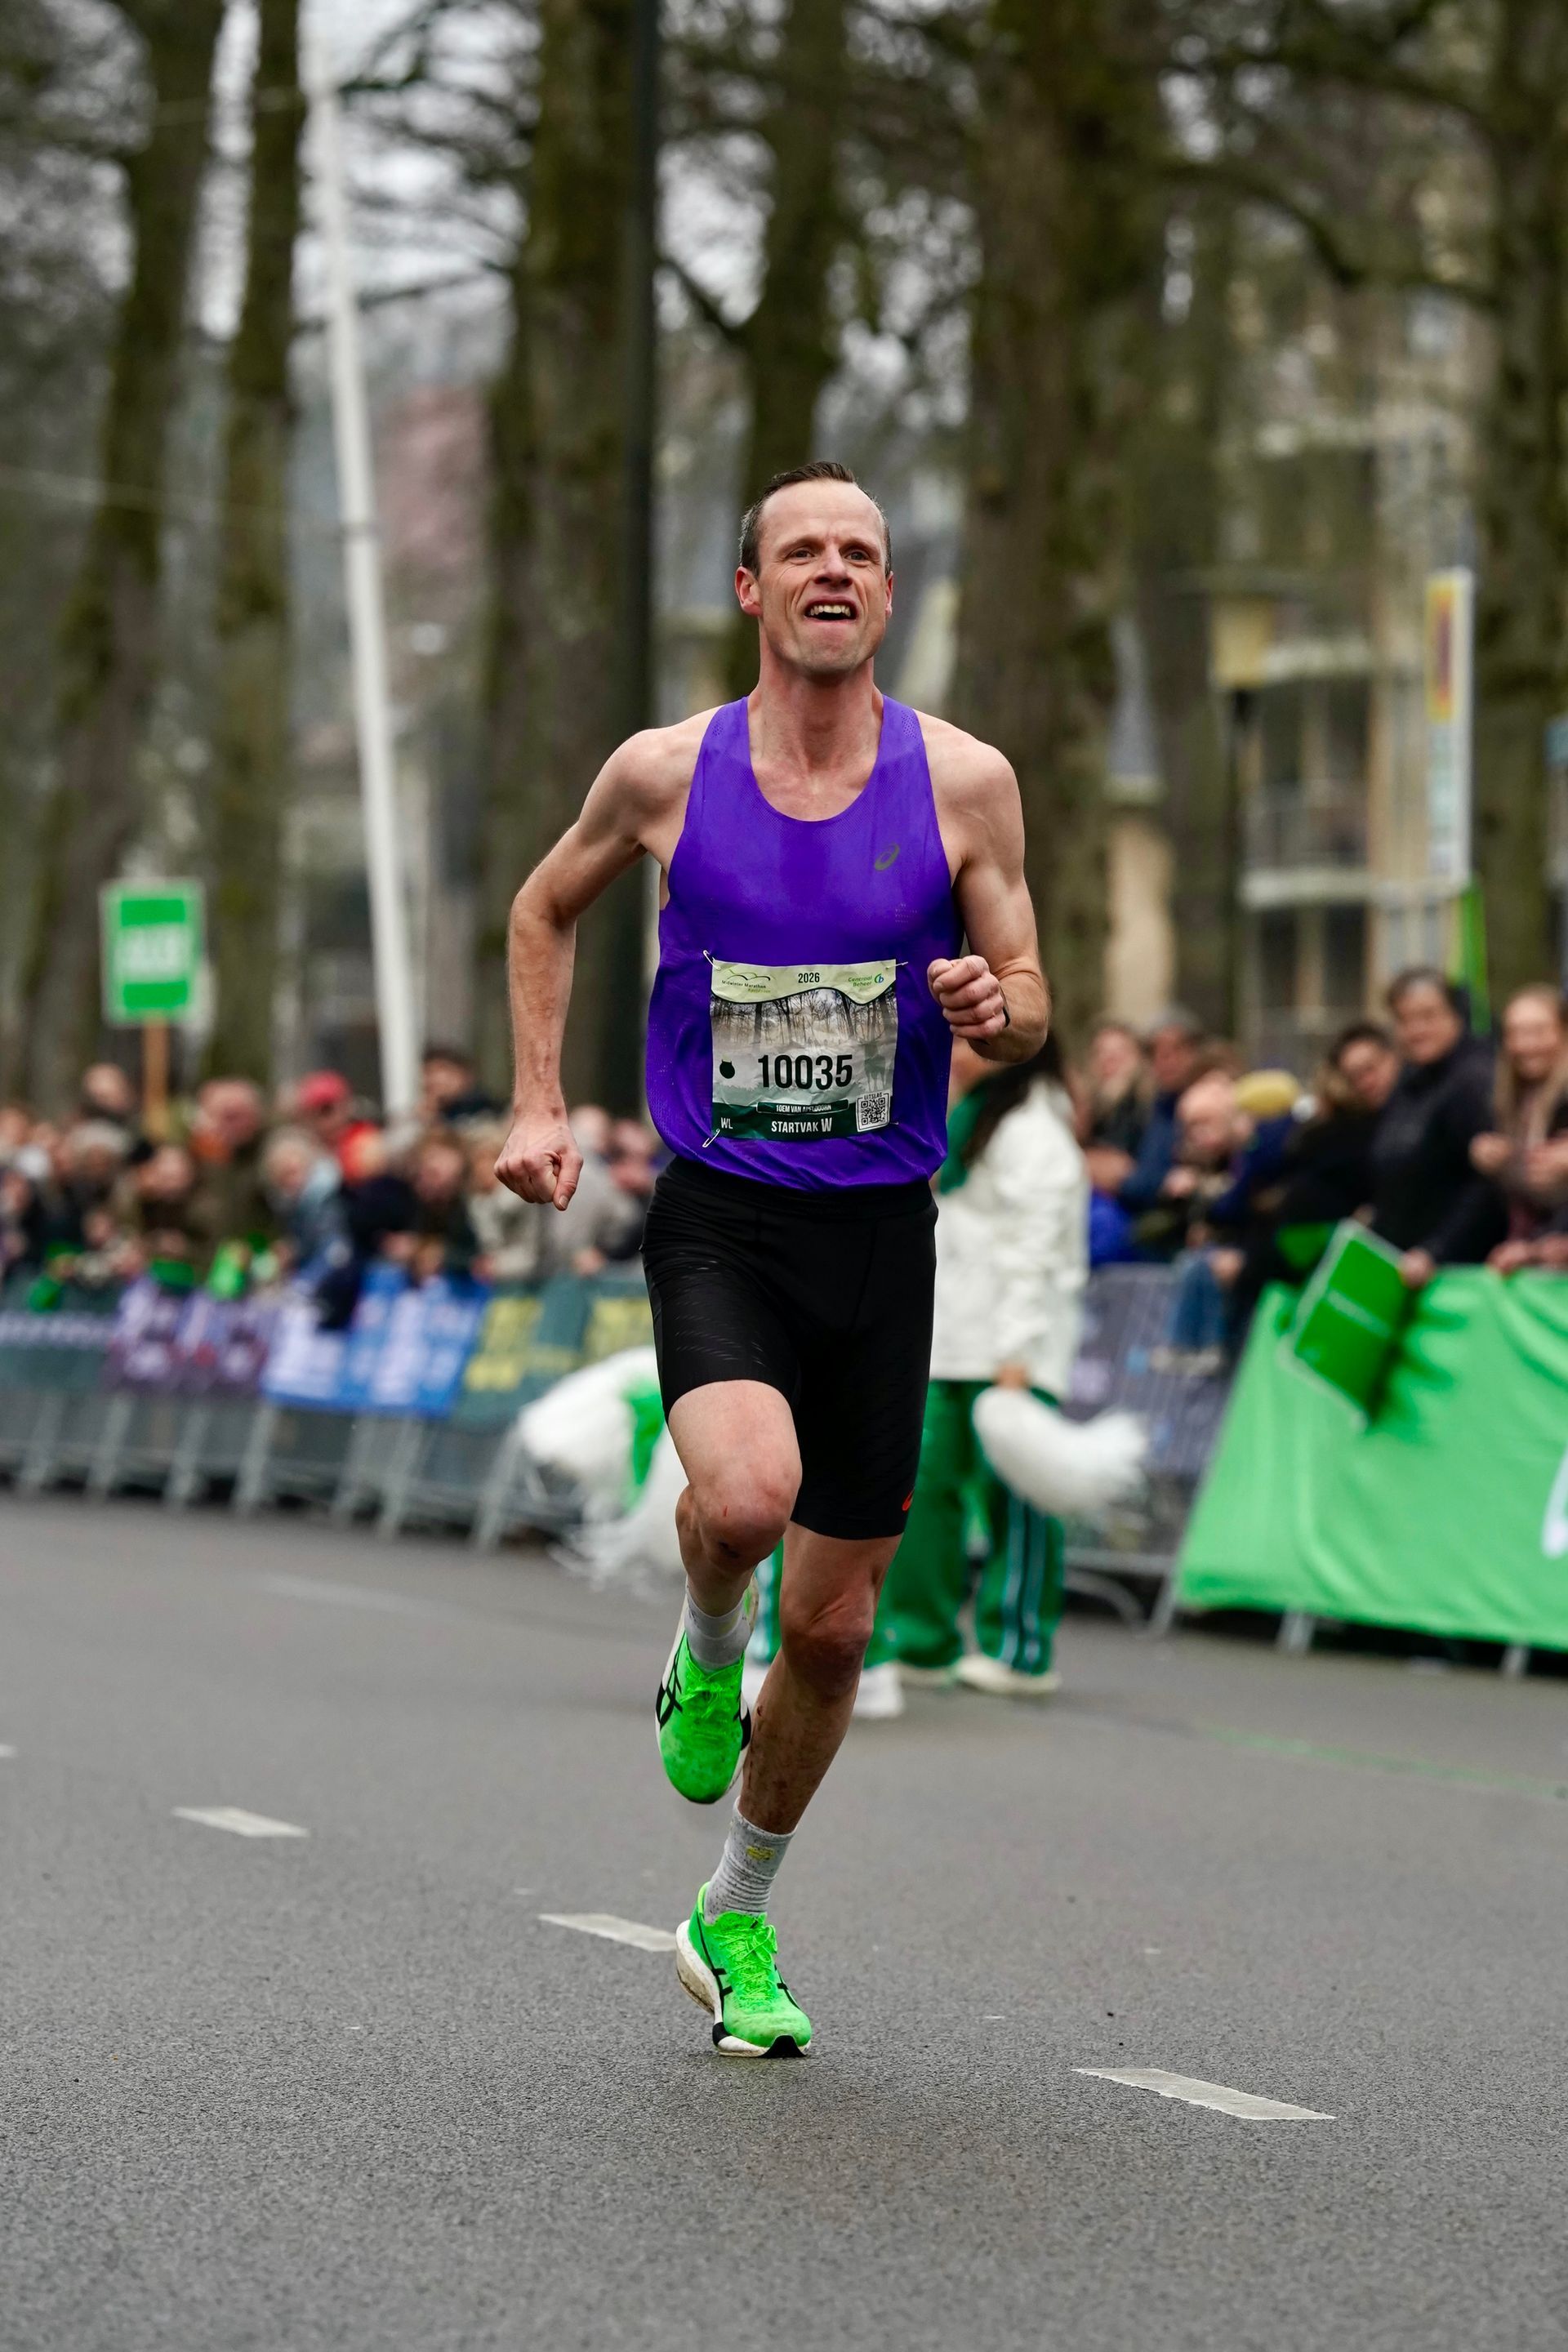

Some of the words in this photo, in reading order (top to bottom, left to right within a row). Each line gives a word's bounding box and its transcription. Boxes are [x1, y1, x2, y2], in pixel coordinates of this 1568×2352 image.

[798, 973, 820, 983] 2026
[758, 1054, 853, 1090] 10035
[863, 1093, 882, 1101] UITSLAG
[720, 1117, 733, 1129] WL
[771, 1120, 818, 1133] STARTVAK
[821, 1117, 833, 1133] W
